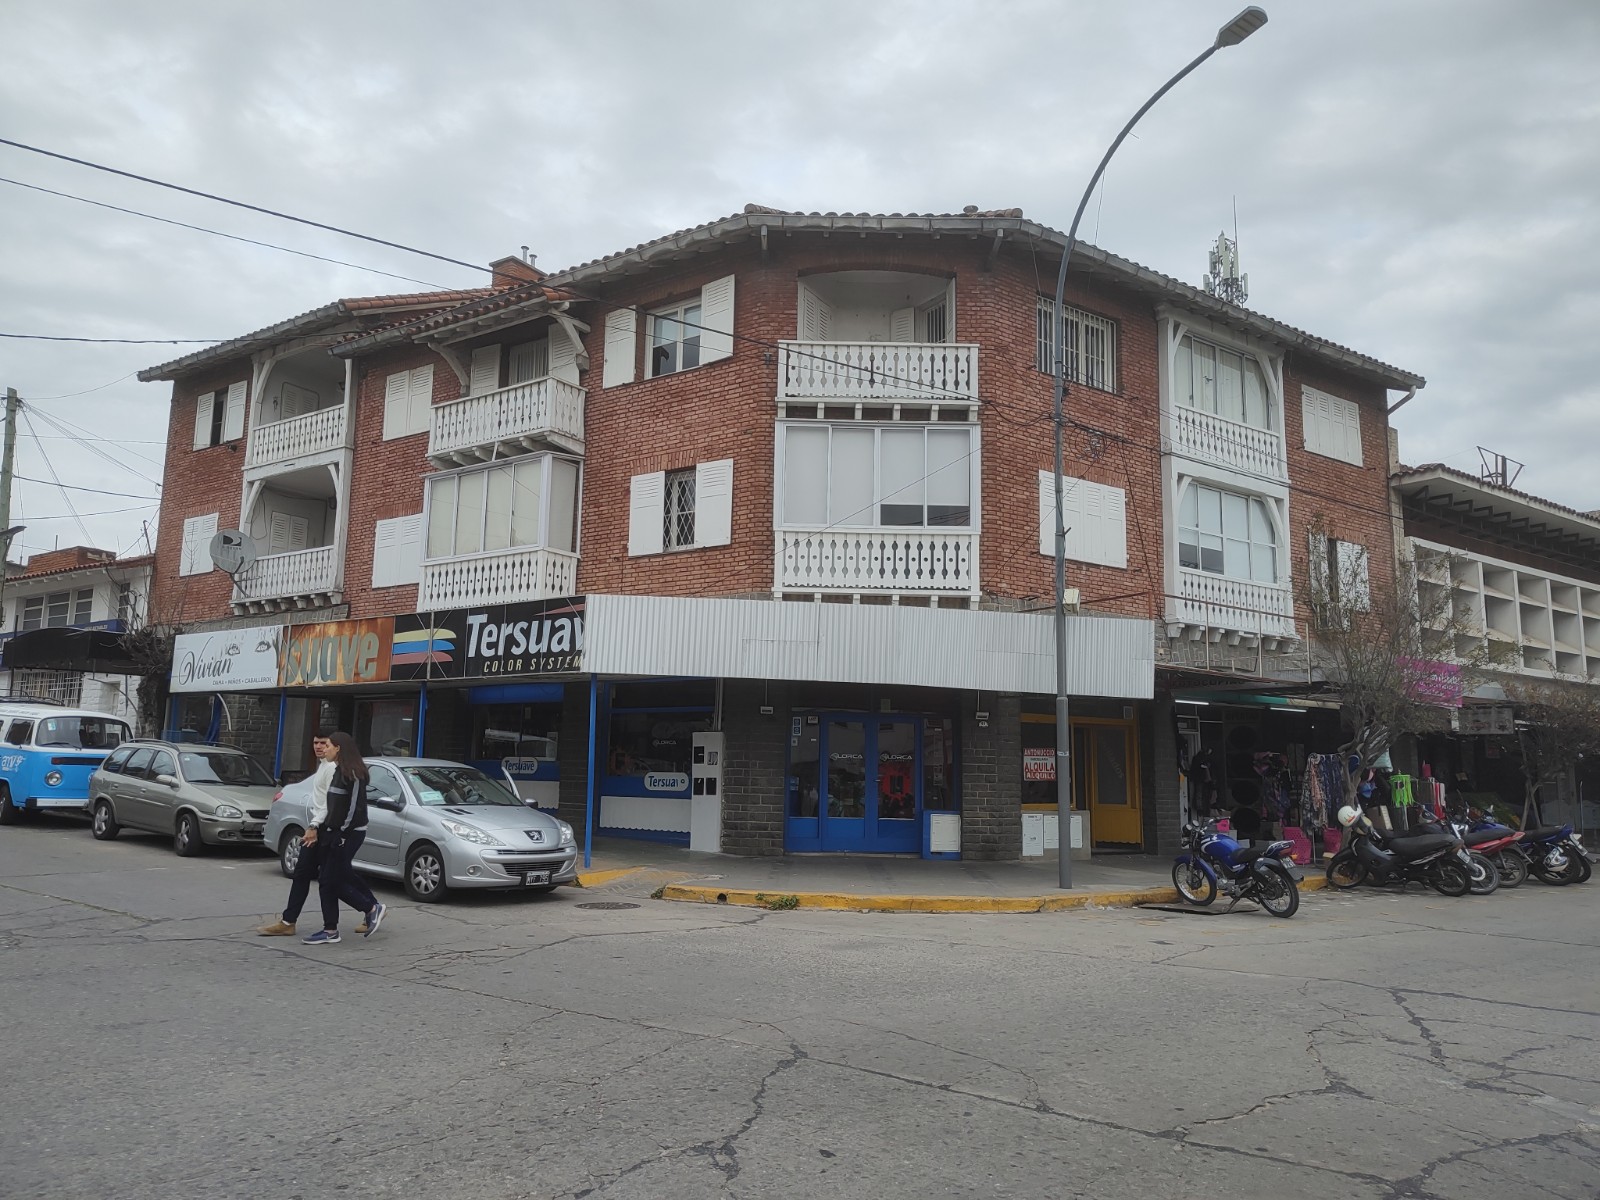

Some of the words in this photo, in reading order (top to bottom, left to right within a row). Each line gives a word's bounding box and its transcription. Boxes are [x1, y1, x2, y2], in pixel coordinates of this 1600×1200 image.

[179, 635, 233, 686] Vivian
[483, 659, 523, 673] COLOR
[1025, 762, 1055, 772] ALQUILA
